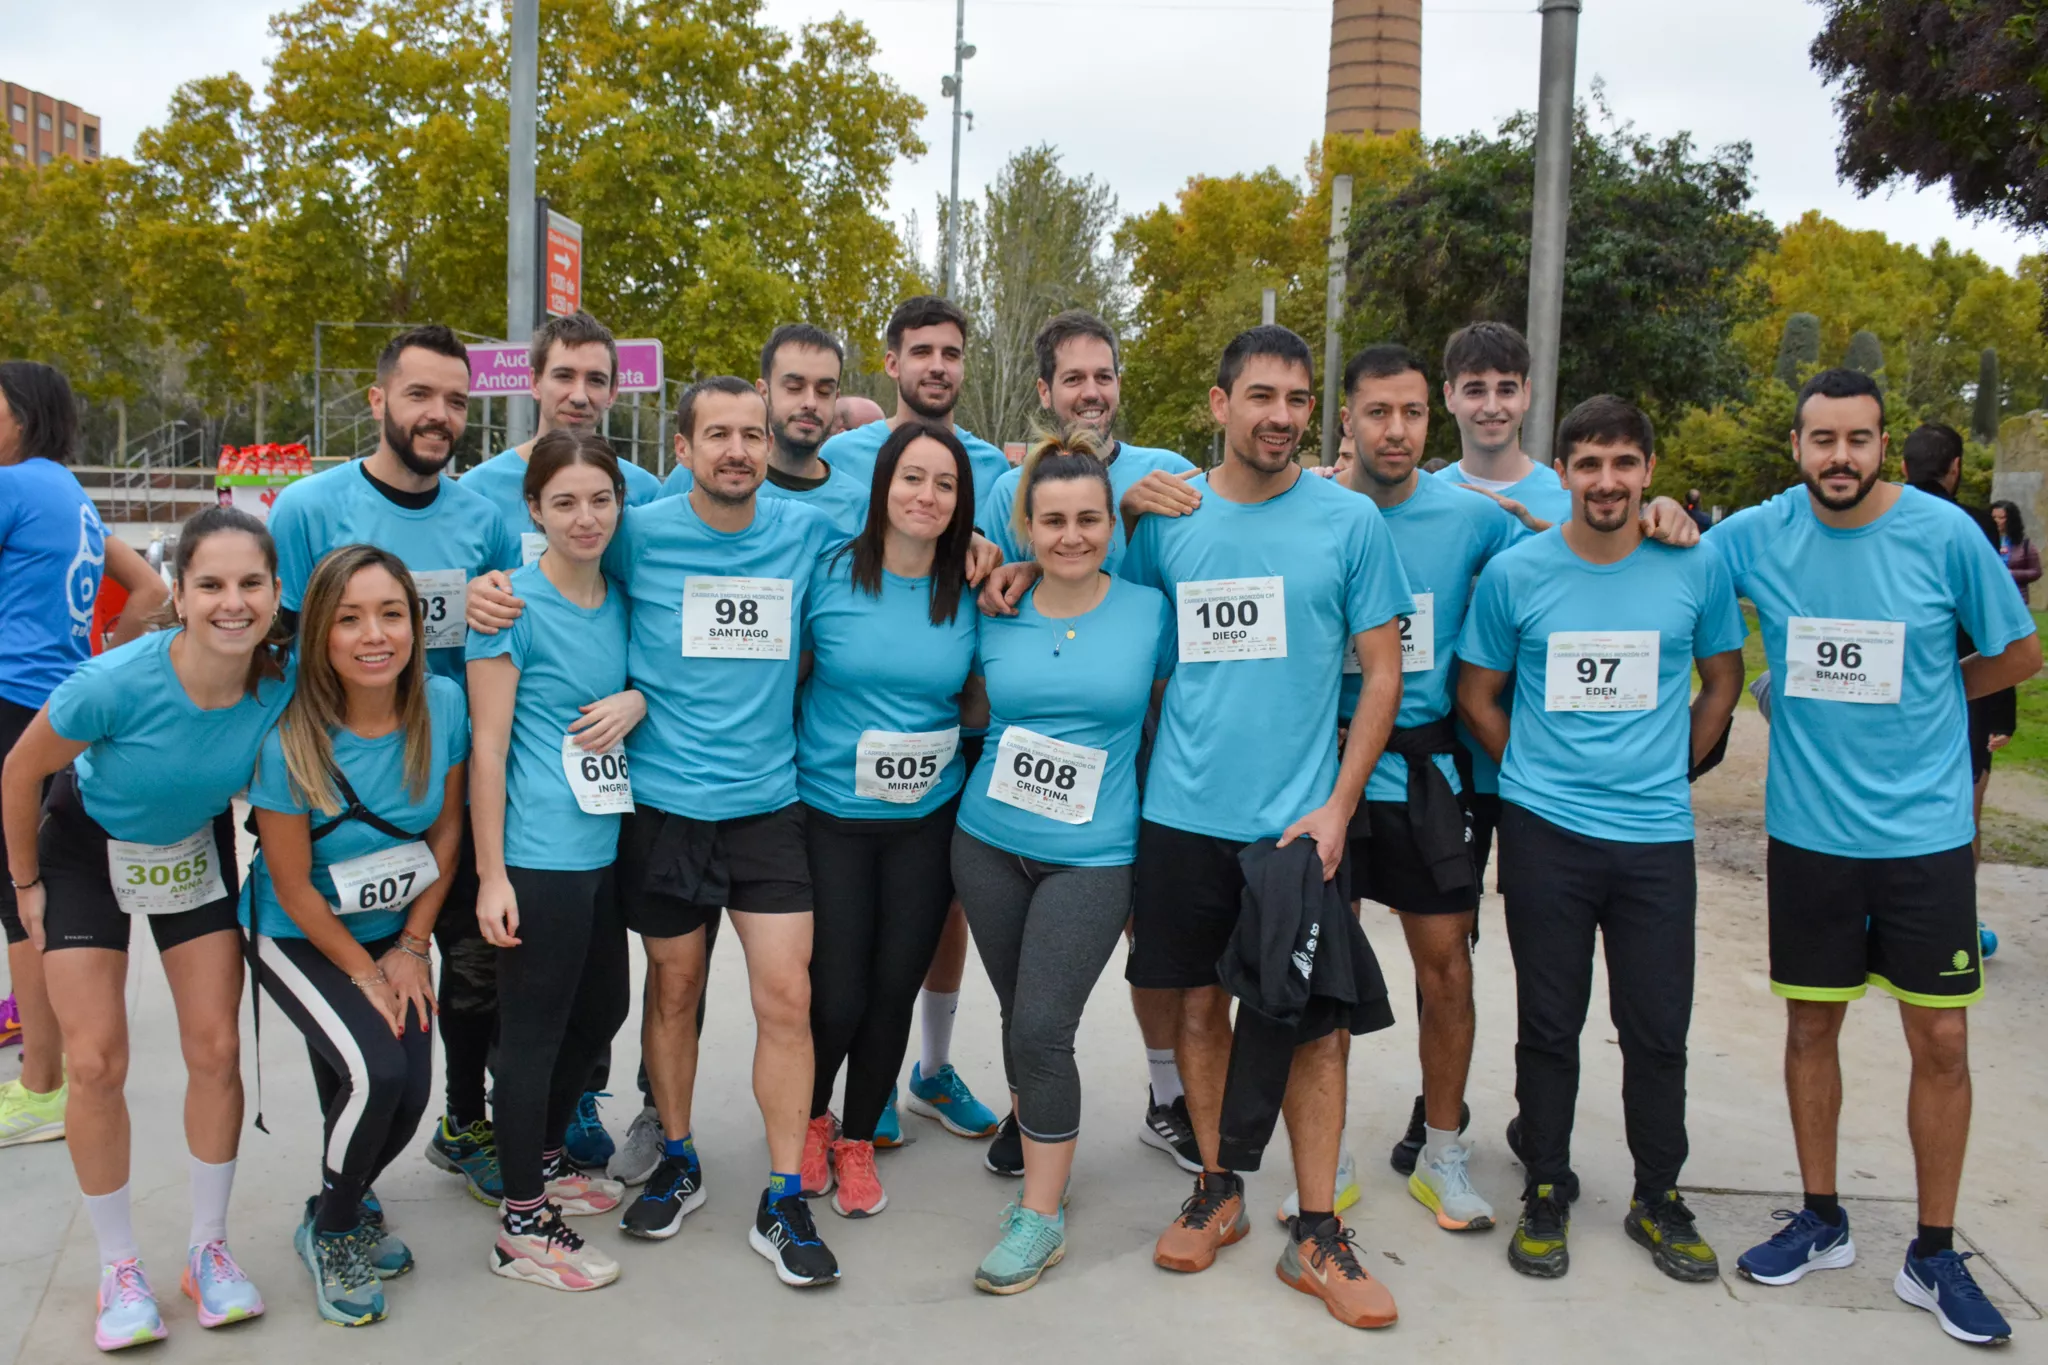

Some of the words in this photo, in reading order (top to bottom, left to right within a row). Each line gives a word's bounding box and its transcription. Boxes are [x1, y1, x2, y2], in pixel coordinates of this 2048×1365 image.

[494, 352, 529, 368] Aud
[476, 373, 529, 388] Anton
[618, 369, 644, 385] eta
[715, 599, 758, 625] 98
[1196, 600, 1258, 628] 100
[709, 628, 768, 638] SANTIAGO
[1213, 630, 1247, 640] DIEGO
[1399, 617, 1412, 640] 2
[1817, 642, 1862, 669] 96
[1577, 658, 1621, 683] 97
[1816, 670, 1866, 681] BRANDO
[1585, 687, 1617, 695] EDEN
[581, 754, 628, 781] 606
[875, 755, 937, 780] 605
[1013, 752, 1077, 790] 608
[599, 783, 628, 793] INGRID
[888, 781, 928, 790] MIRIAM
[1016, 780, 1068, 802] CRISTINA
[126, 850, 208, 886] 3065
[170, 878, 204, 894] ANNA
[360, 871, 416, 908] 607
